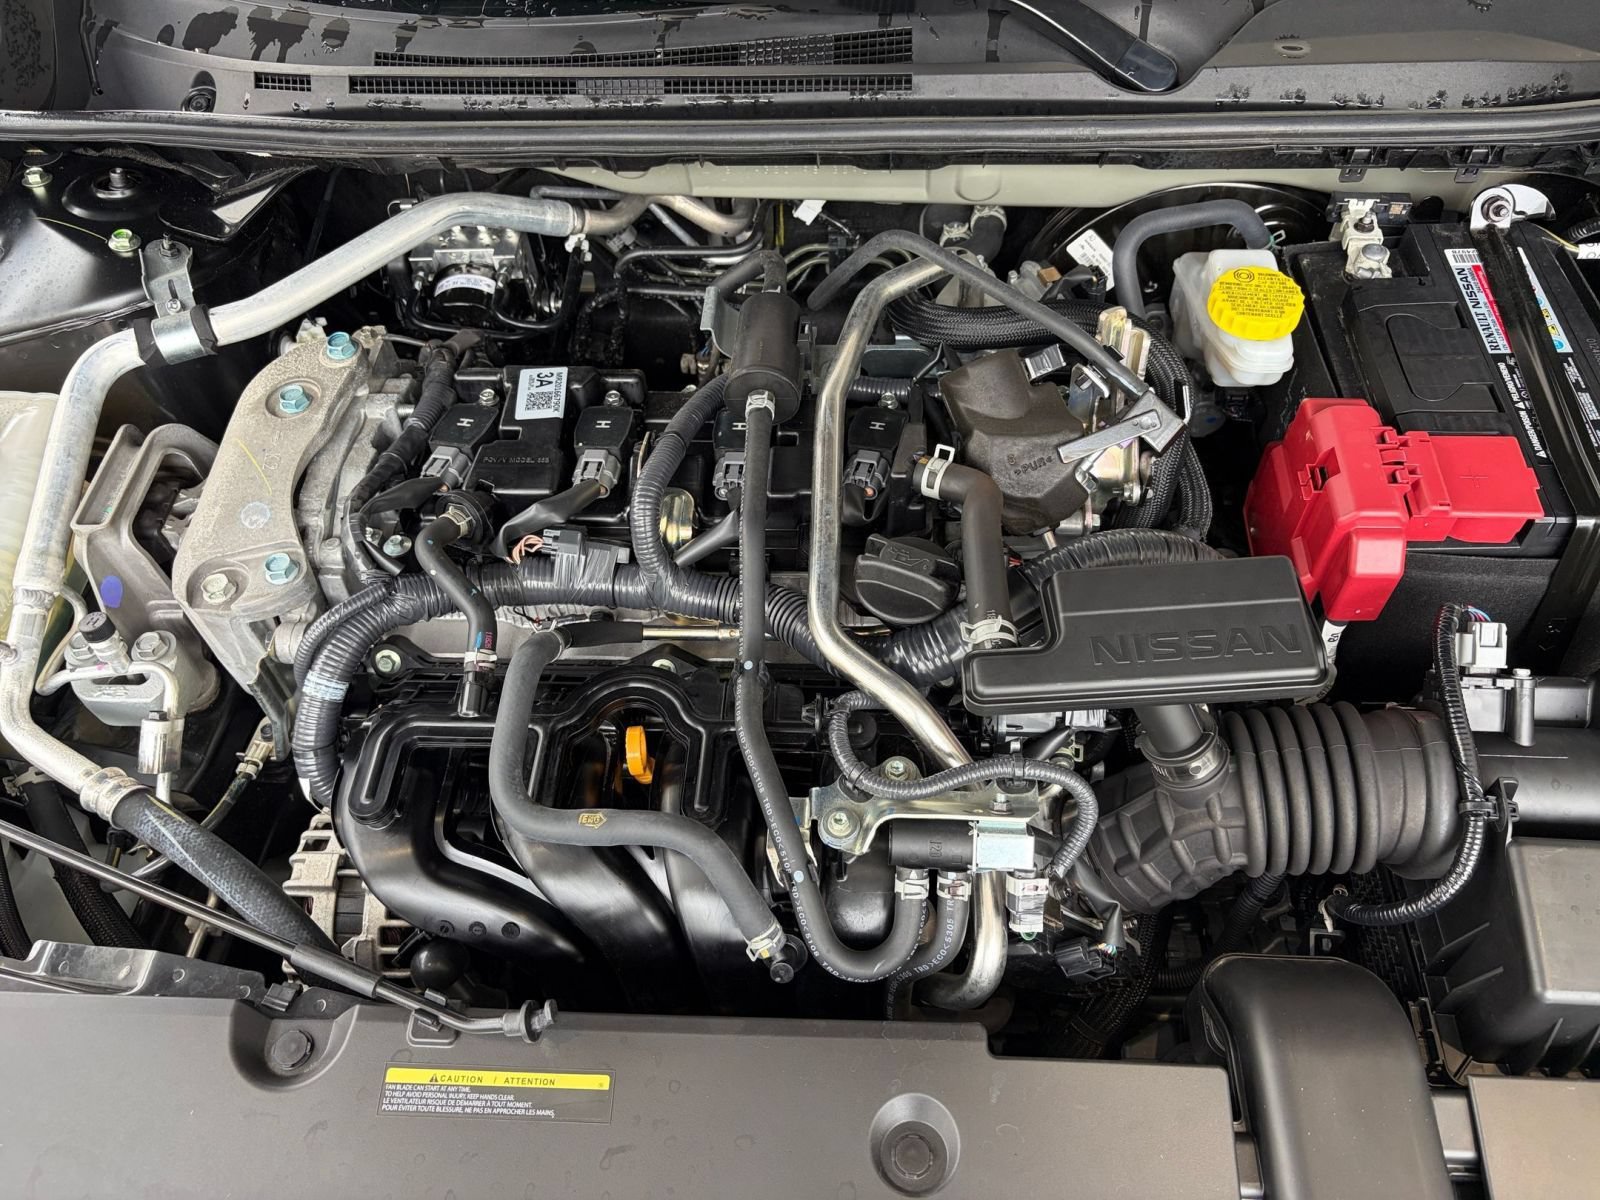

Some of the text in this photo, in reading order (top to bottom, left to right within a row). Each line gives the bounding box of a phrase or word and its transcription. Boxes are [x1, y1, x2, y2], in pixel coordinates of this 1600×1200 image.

[1455, 268, 1482, 309] NISSAN
[1475, 311, 1502, 351] RENAULT
[536, 372, 554, 388] 3A
[1089, 624, 1302, 666] NISSAN
[440, 1075, 484, 1083] CAUTION
[503, 1077, 556, 1086] ATTENTION
